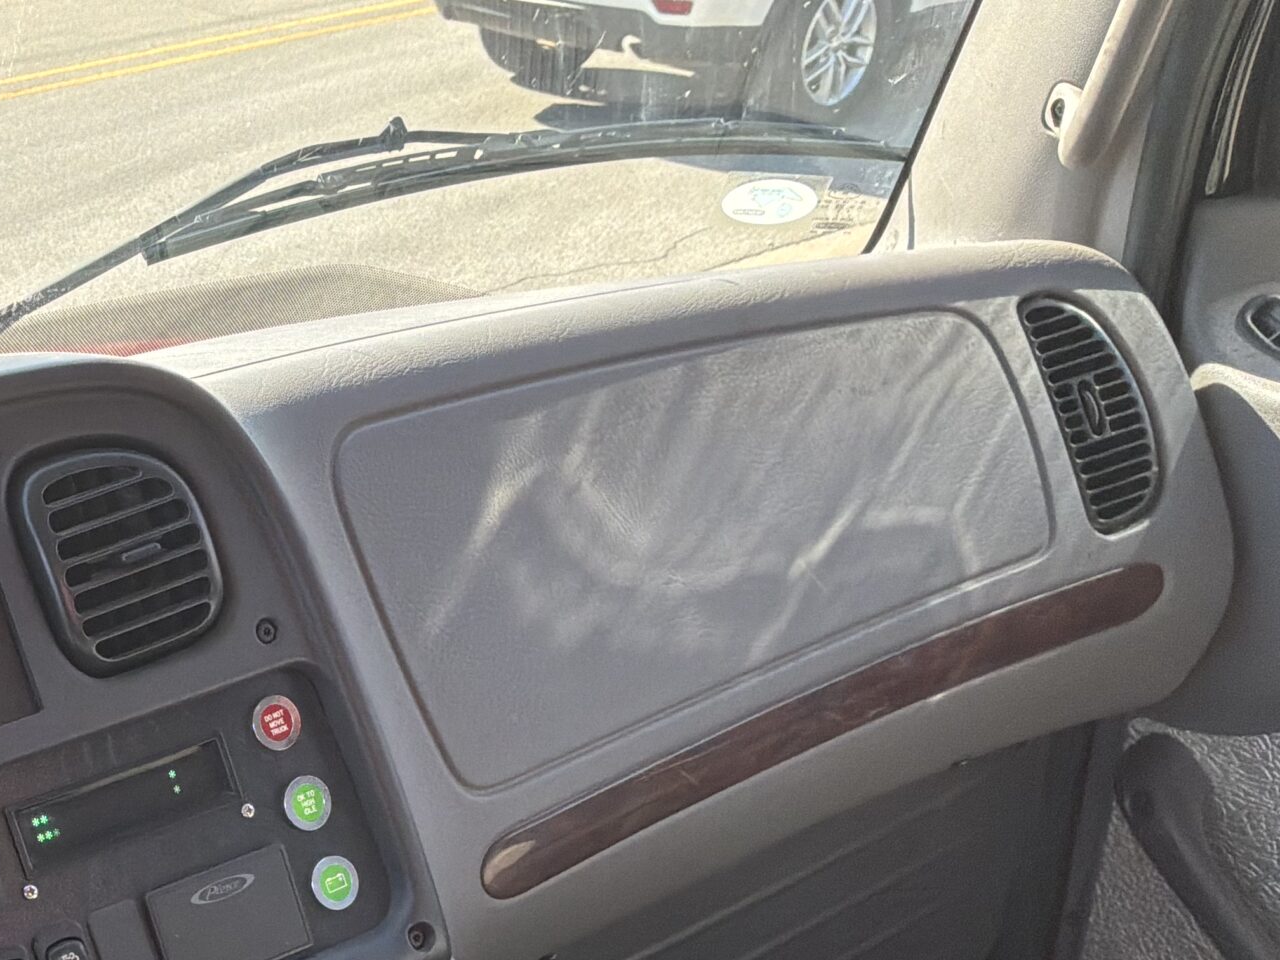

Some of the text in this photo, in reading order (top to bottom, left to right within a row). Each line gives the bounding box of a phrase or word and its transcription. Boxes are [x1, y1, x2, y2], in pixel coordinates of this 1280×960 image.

[264, 709, 284, 722] DO NOT
[269, 717, 285, 728] MOVE
[271, 725, 288, 736] TRUCK
